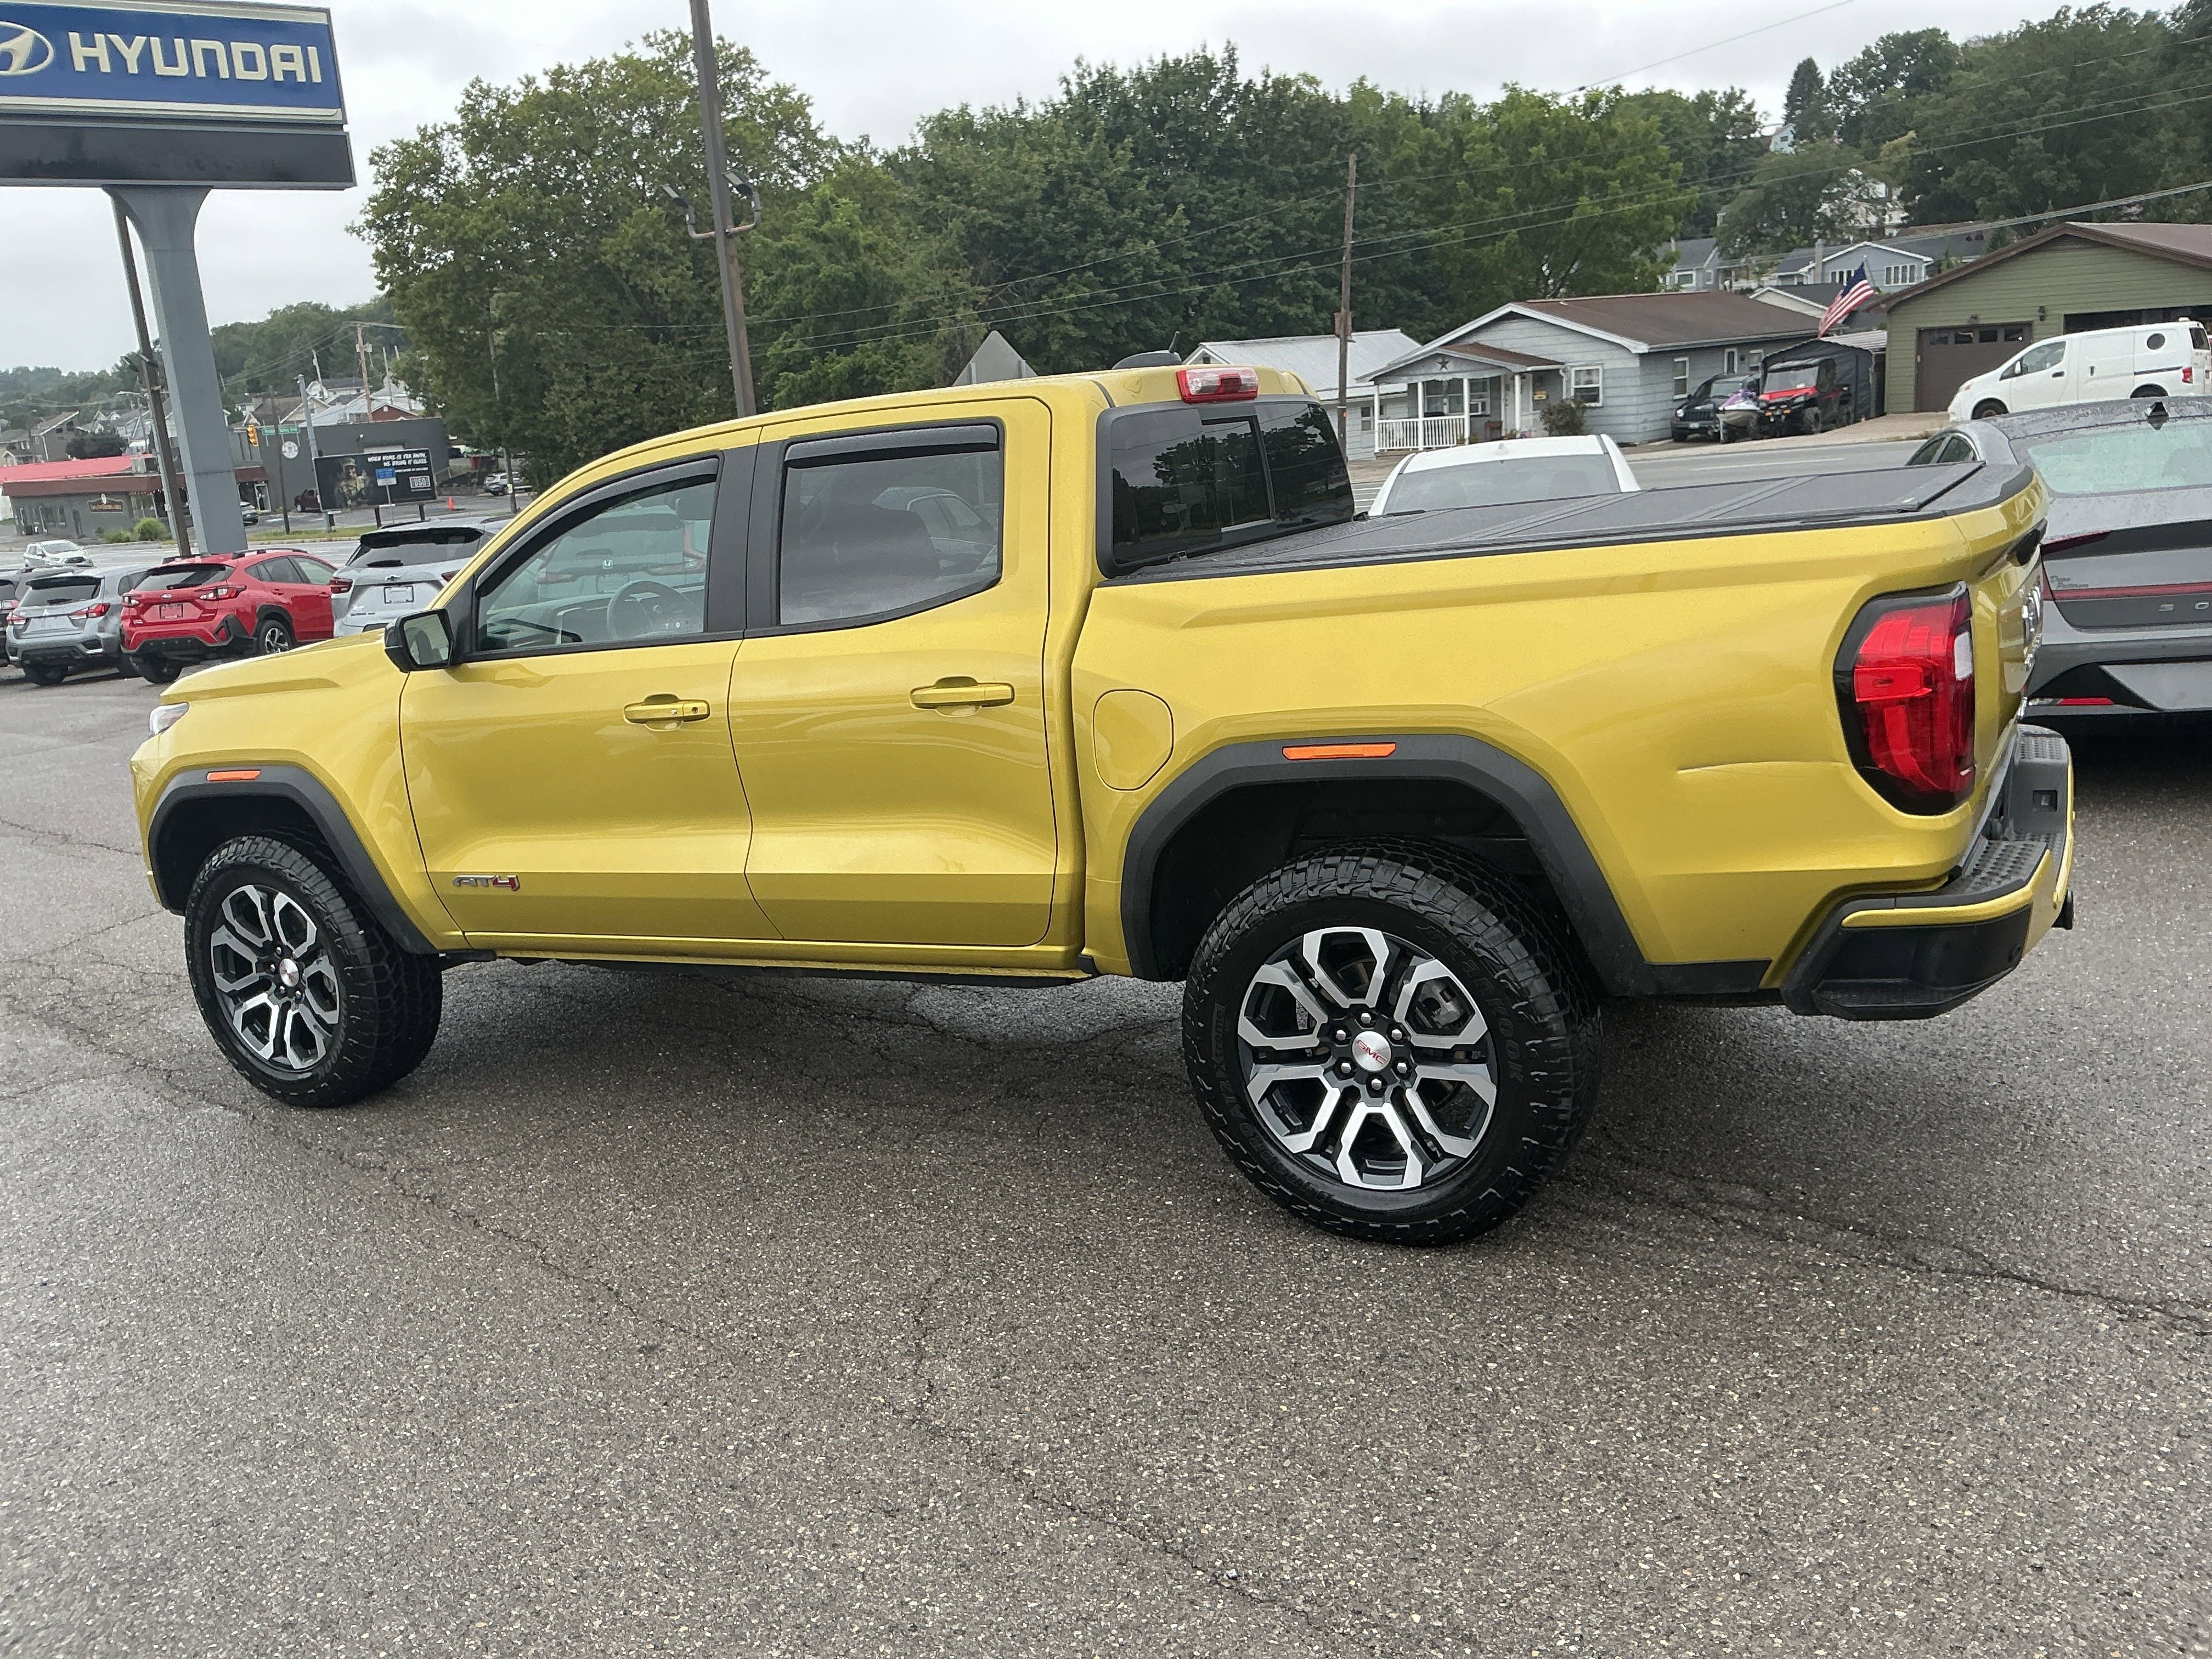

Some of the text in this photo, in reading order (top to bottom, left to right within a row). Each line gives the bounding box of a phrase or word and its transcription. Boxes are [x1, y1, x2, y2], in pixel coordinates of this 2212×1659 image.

[67, 31, 322, 83] HYUNDAI
[414, 477, 426, 487] USO
[452, 874, 520, 891] AT4
[1356, 1039, 1387, 1064] GMC
